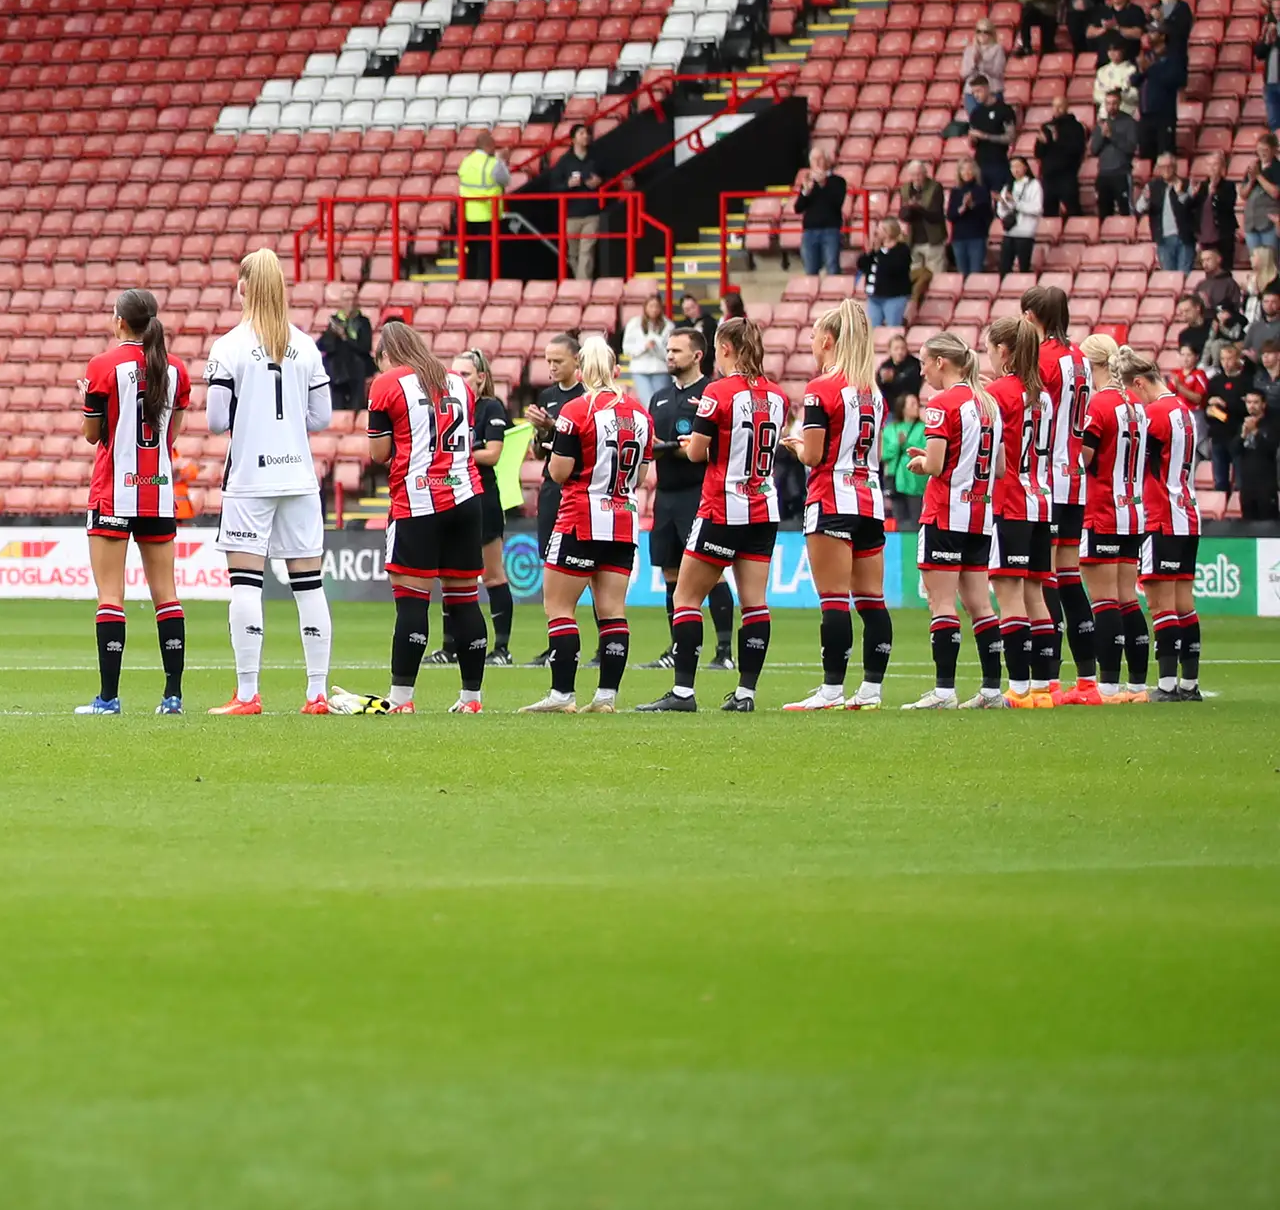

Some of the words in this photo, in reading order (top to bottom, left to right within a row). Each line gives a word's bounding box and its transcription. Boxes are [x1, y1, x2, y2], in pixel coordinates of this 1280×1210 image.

[267, 363, 284, 420] 1
[1069, 384, 1090, 438] 10
[418, 396, 466, 452] 12
[741, 421, 777, 477] 18
[851, 414, 875, 468] 3
[1019, 419, 1052, 474] 24
[267, 454, 302, 466] Doordeals
[605, 440, 641, 496] 19
[974, 426, 996, 481] 9
[1122, 431, 1141, 482] 11
